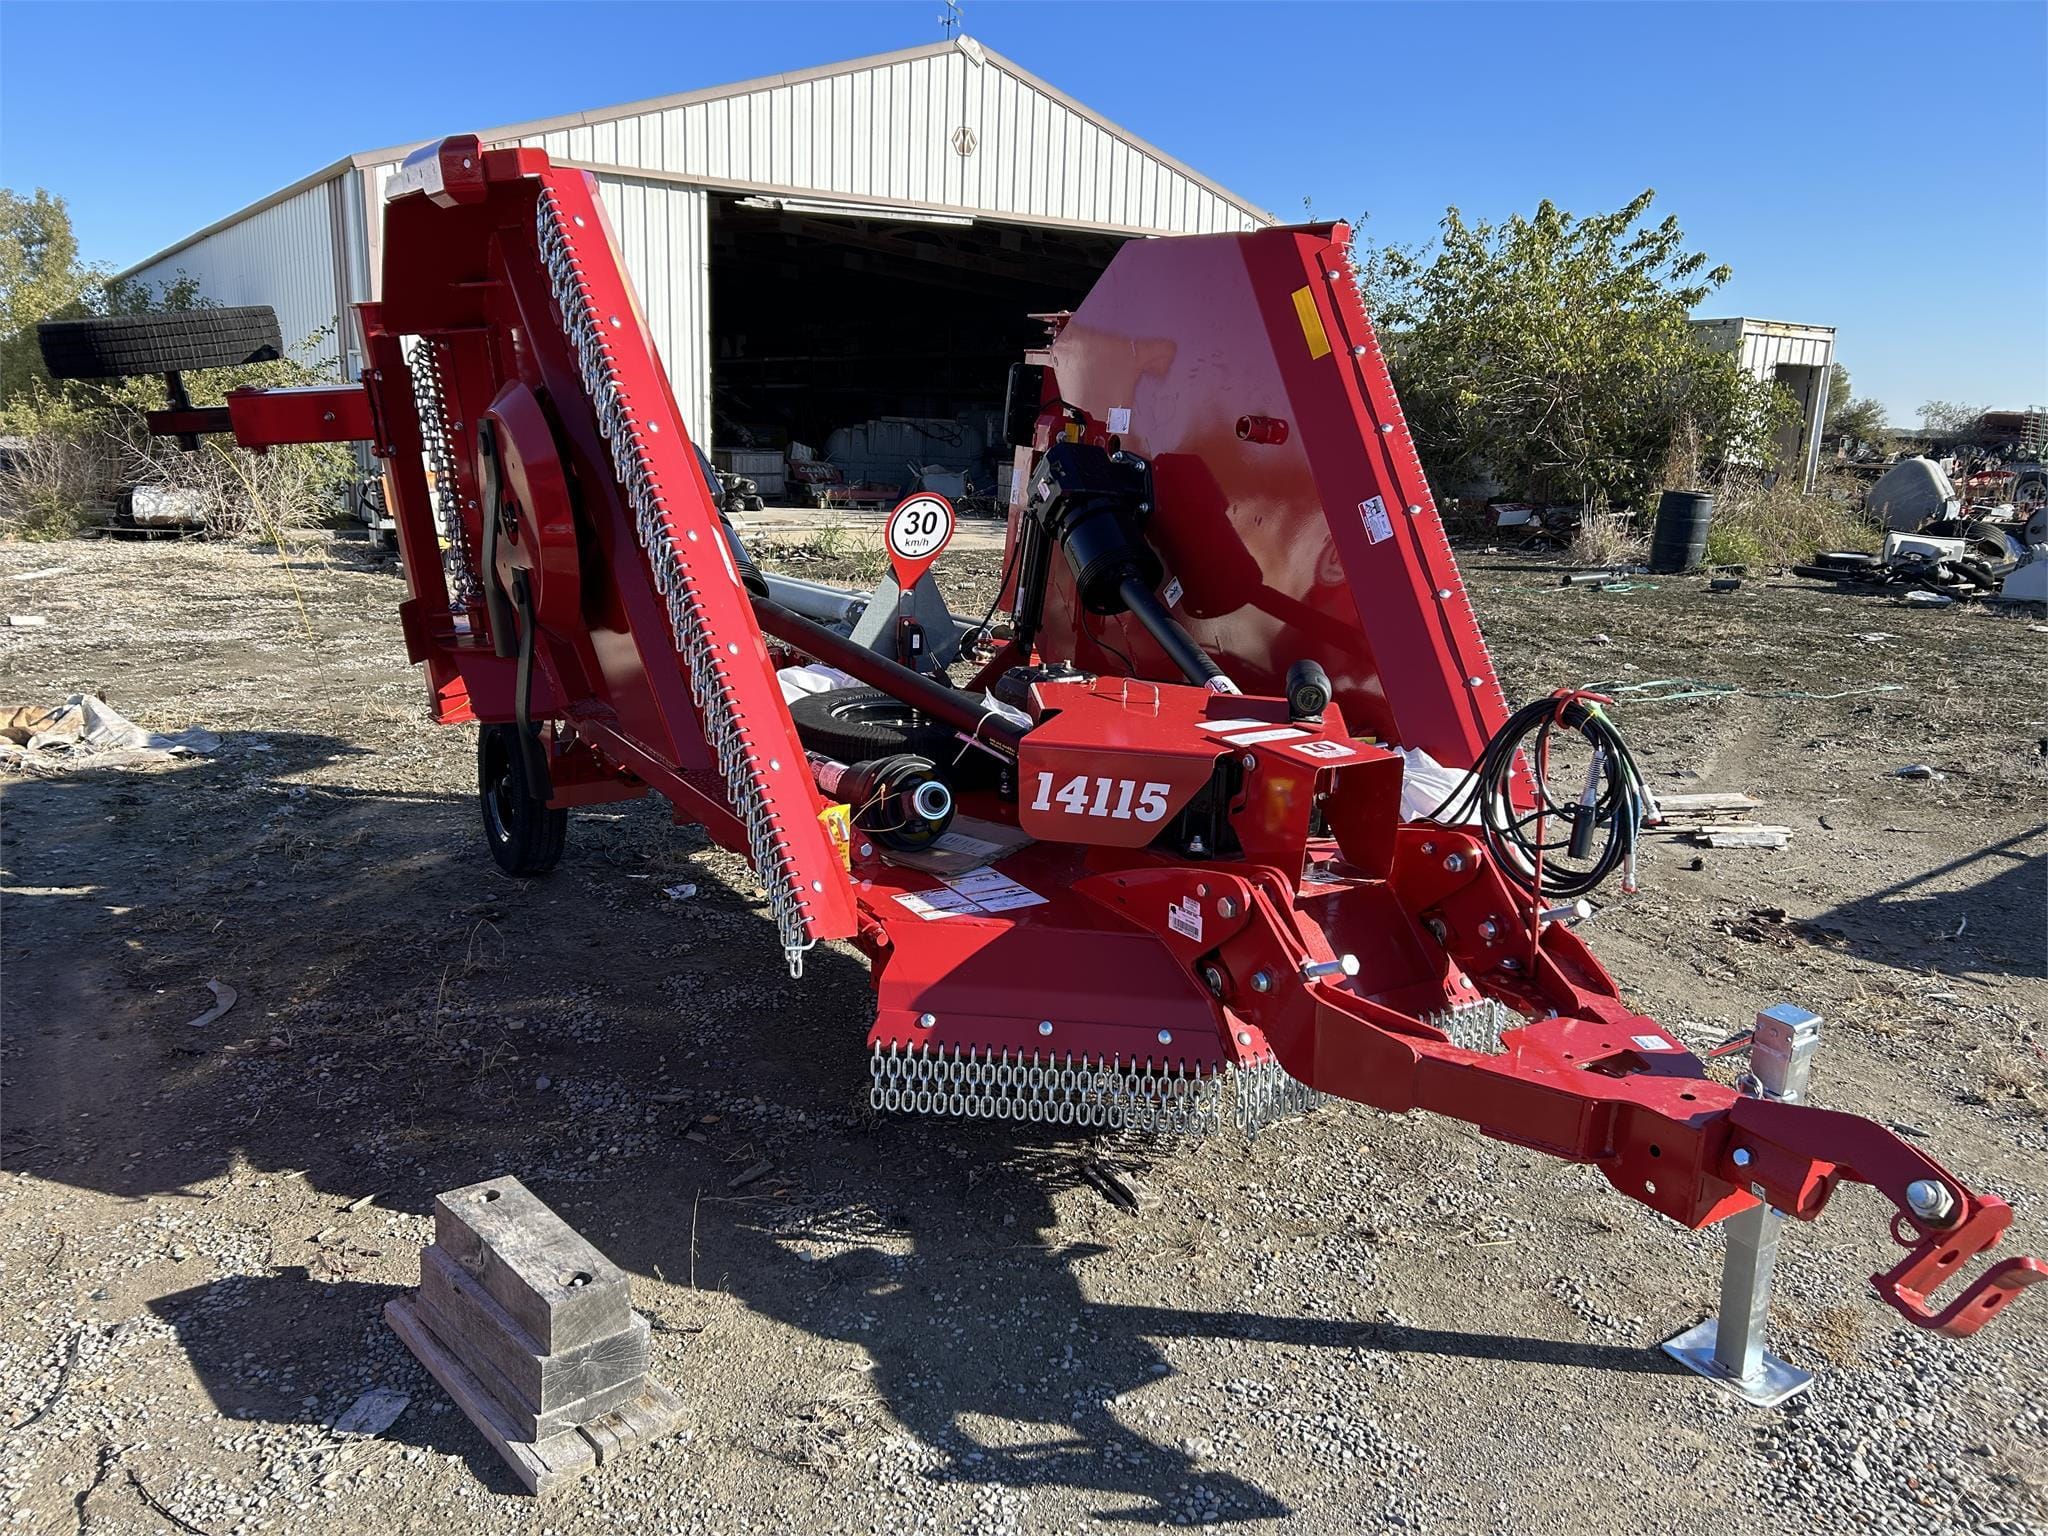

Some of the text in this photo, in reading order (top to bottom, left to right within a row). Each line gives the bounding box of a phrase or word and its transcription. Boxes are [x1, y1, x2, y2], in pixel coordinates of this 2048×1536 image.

[904, 511, 938, 535] 30
[904, 538, 929, 547] km/h
[1031, 772, 1171, 822] 14115
